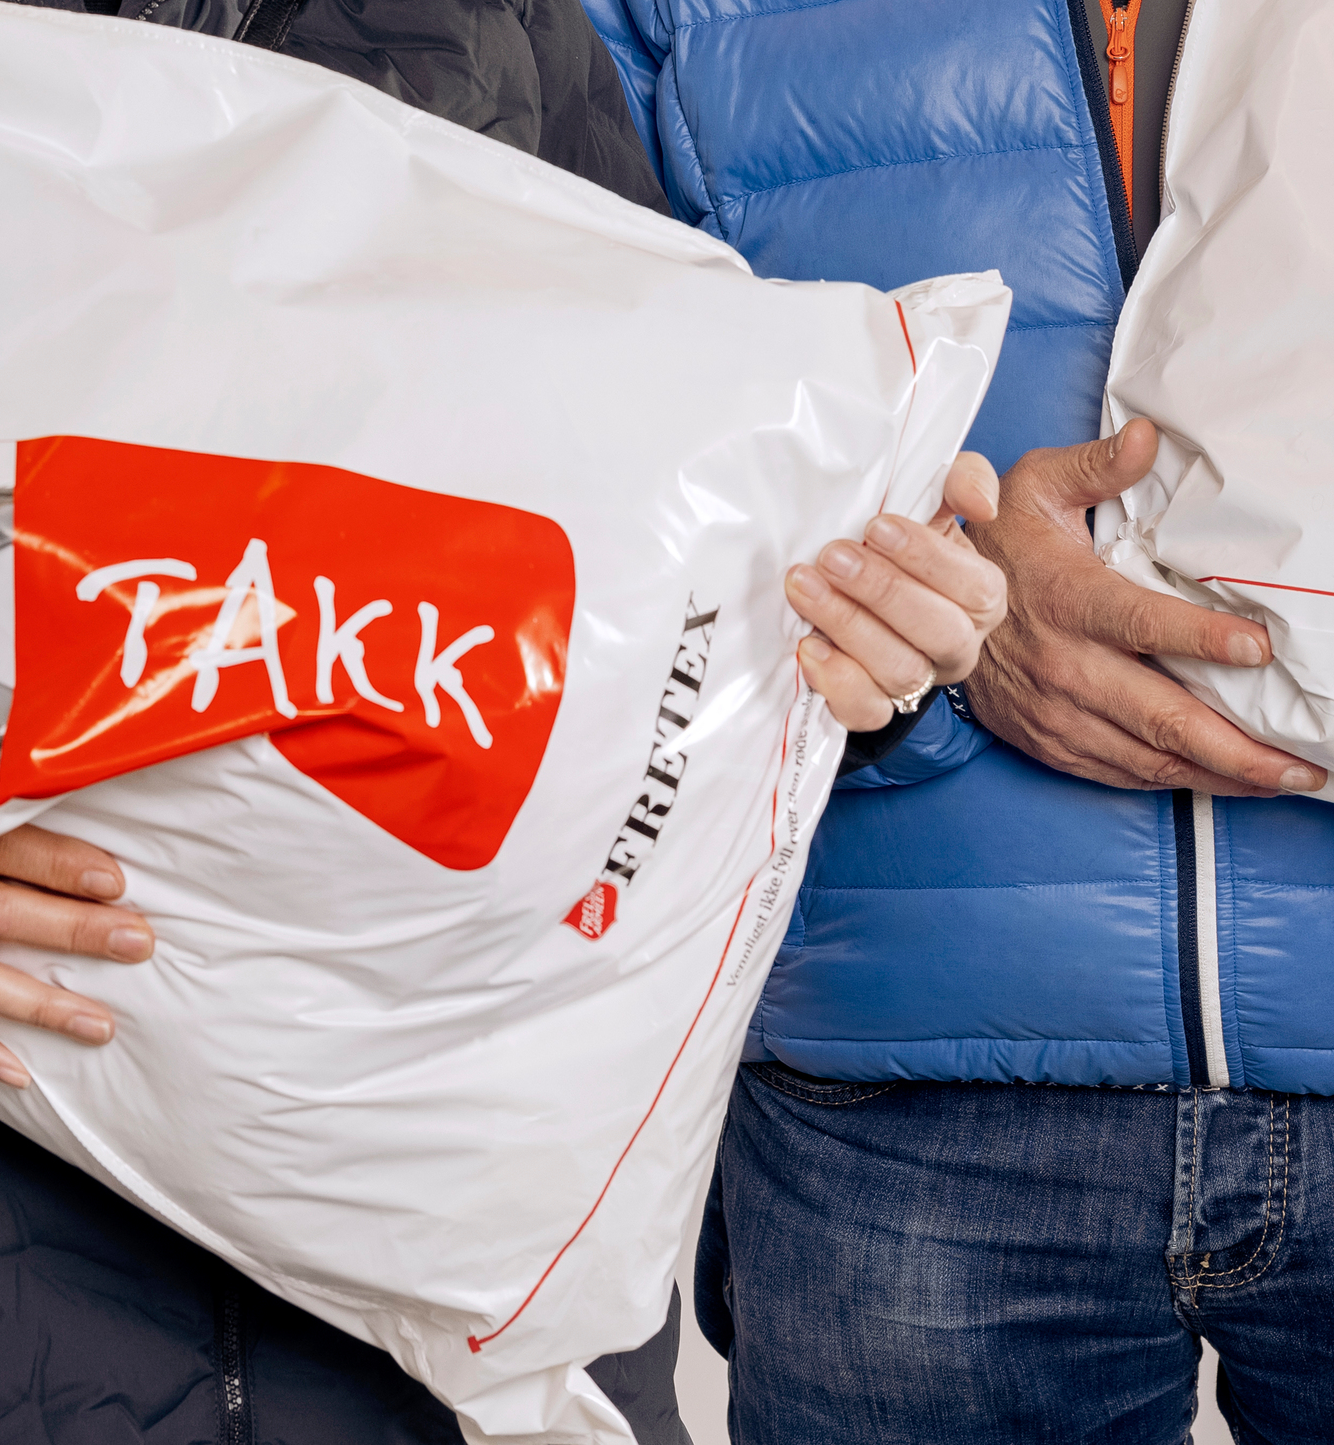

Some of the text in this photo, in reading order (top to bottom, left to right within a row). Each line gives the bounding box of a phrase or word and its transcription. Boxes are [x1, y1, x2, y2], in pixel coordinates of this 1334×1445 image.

[76, 538, 496, 750] TAKK
[602, 590, 721, 887] FRETEX
[727, 912, 768, 989] Vennligst
[760, 876, 783, 912] ikke
